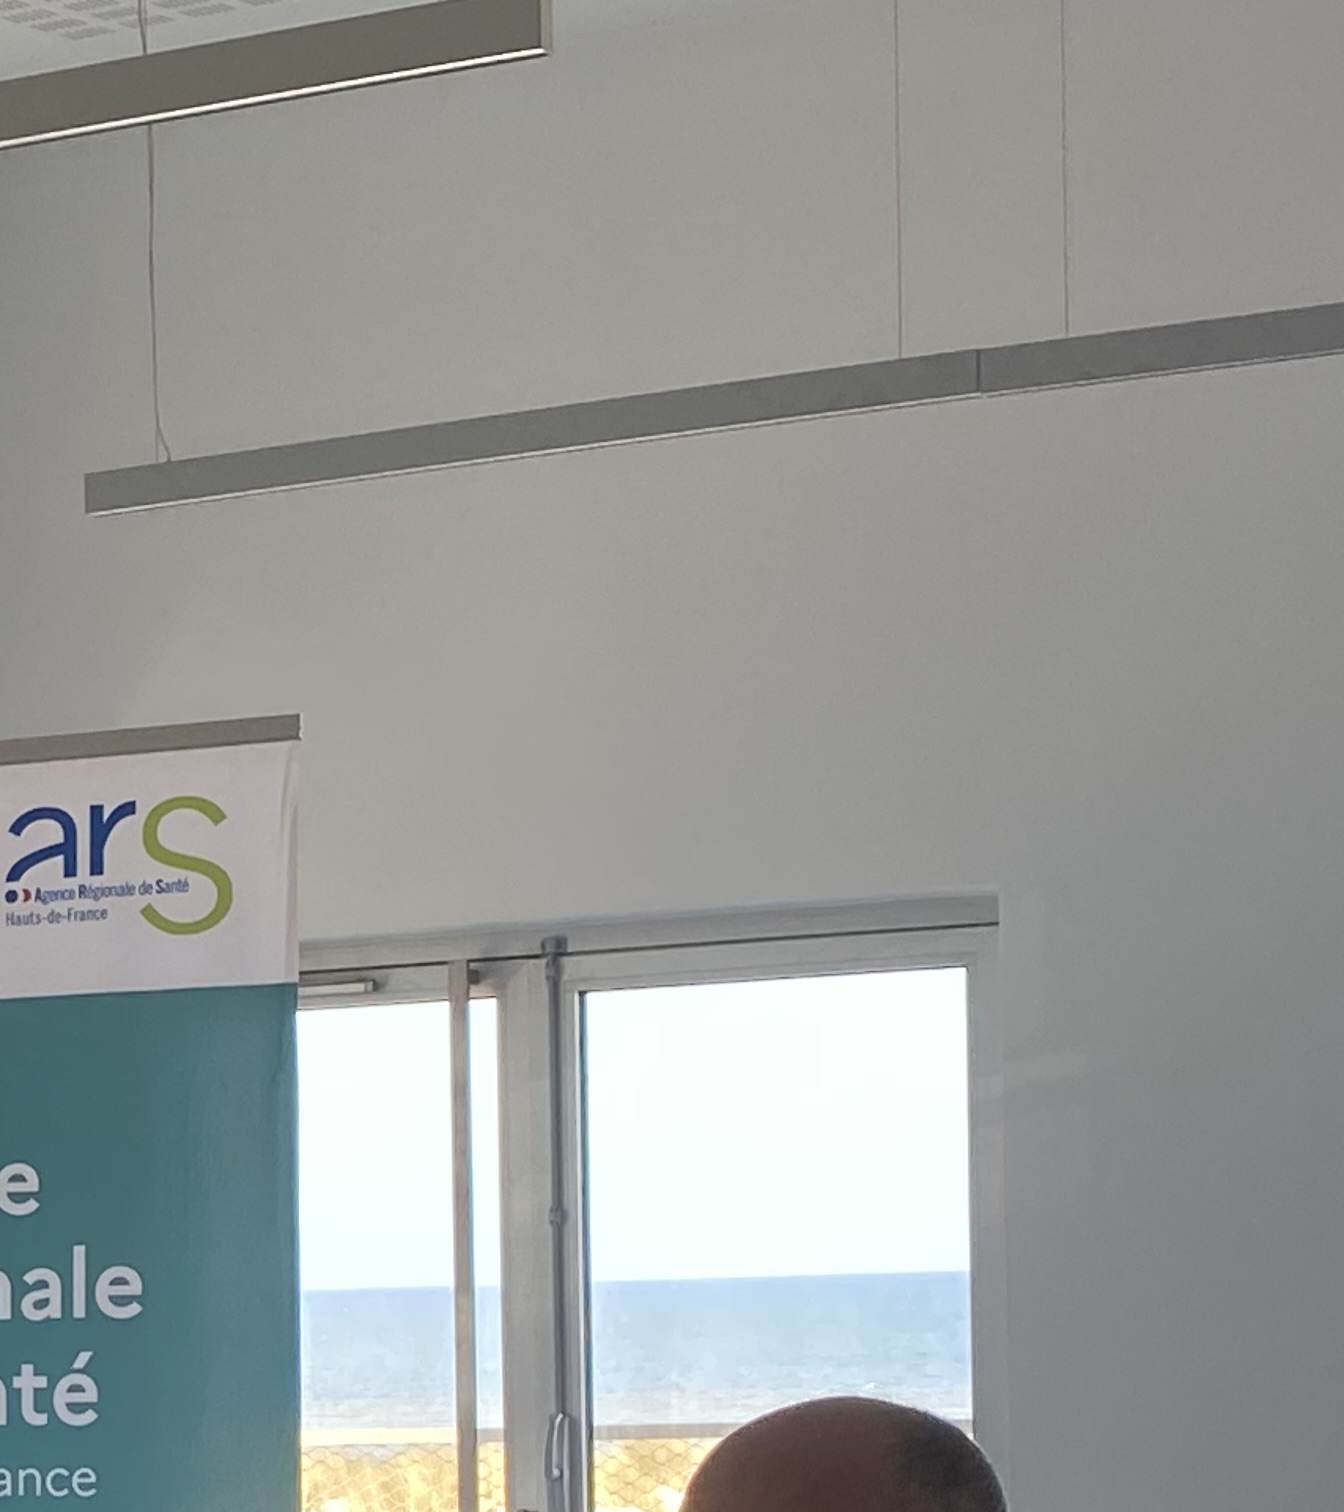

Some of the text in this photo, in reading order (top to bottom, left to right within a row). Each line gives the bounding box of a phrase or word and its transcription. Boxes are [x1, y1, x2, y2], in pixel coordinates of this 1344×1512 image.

[6, 795, 233, 936] ars
[34, 877, 190, 905] Agence Régionale de Santé
[6, 907, 108, 927] Hauts-de-France
